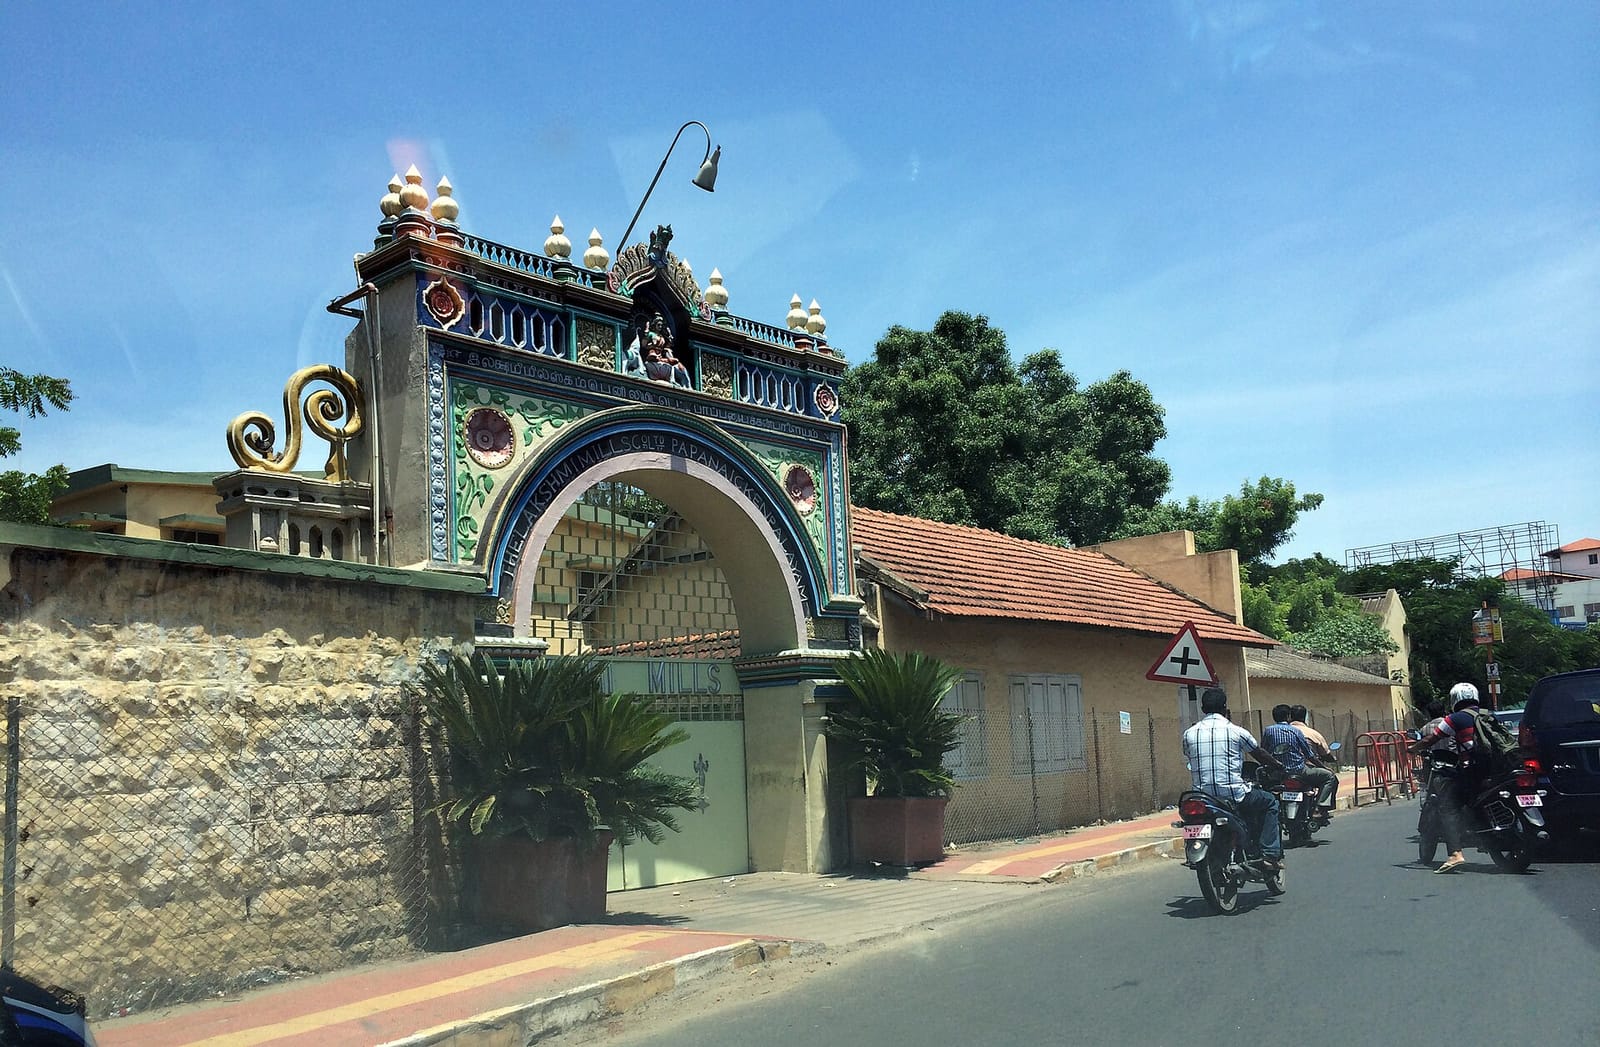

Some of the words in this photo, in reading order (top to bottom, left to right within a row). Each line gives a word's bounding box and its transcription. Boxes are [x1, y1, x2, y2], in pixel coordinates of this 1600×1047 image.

[577, 436, 632, 470] MILLS
[513, 456, 579, 540] LAKSHMI
[503, 535, 524, 578] THE
[647, 661, 722, 694] MILLS
